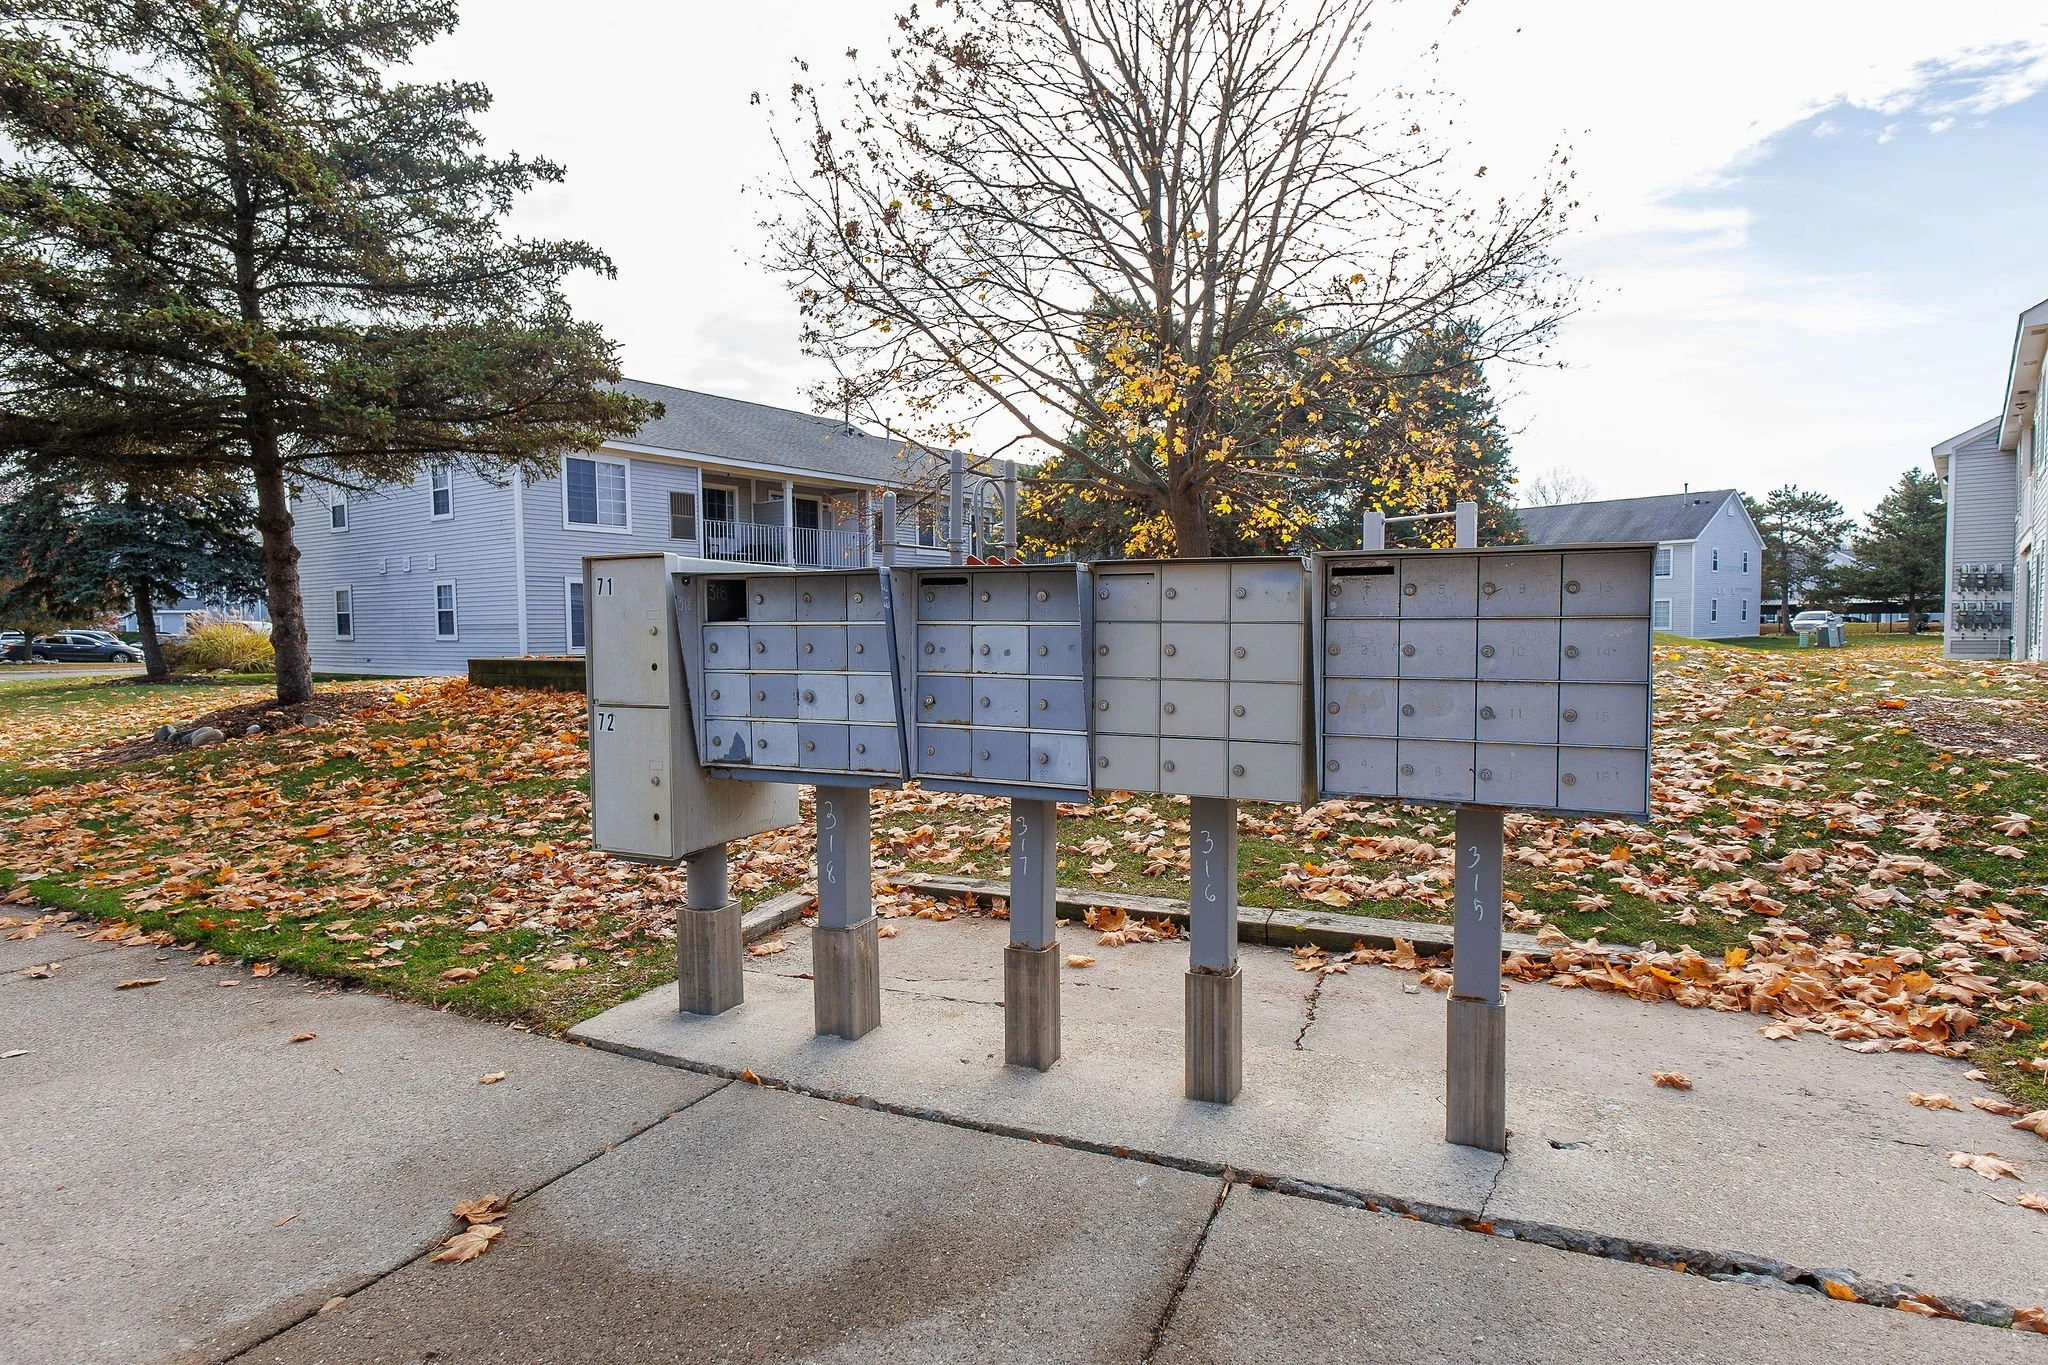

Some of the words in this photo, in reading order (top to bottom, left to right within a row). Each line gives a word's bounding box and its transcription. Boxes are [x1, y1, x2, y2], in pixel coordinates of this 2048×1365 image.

[597, 578, 613, 596] 71
[707, 584, 728, 600] 318
[1438, 584, 1446, 595] 5
[1518, 582, 1526, 594] 9
[1361, 645, 1368, 656] 2
[1597, 647, 1610, 658] 14
[1509, 708, 1523, 720] 11
[598, 713, 614, 732] 72
[1360, 758, 1368, 769] 4
[1434, 766, 1442, 777] 8
[824, 800, 837, 884] 318
[1015, 815, 1029, 876] 317
[1200, 829, 1217, 902] 316
[1466, 845, 1484, 922] 315
